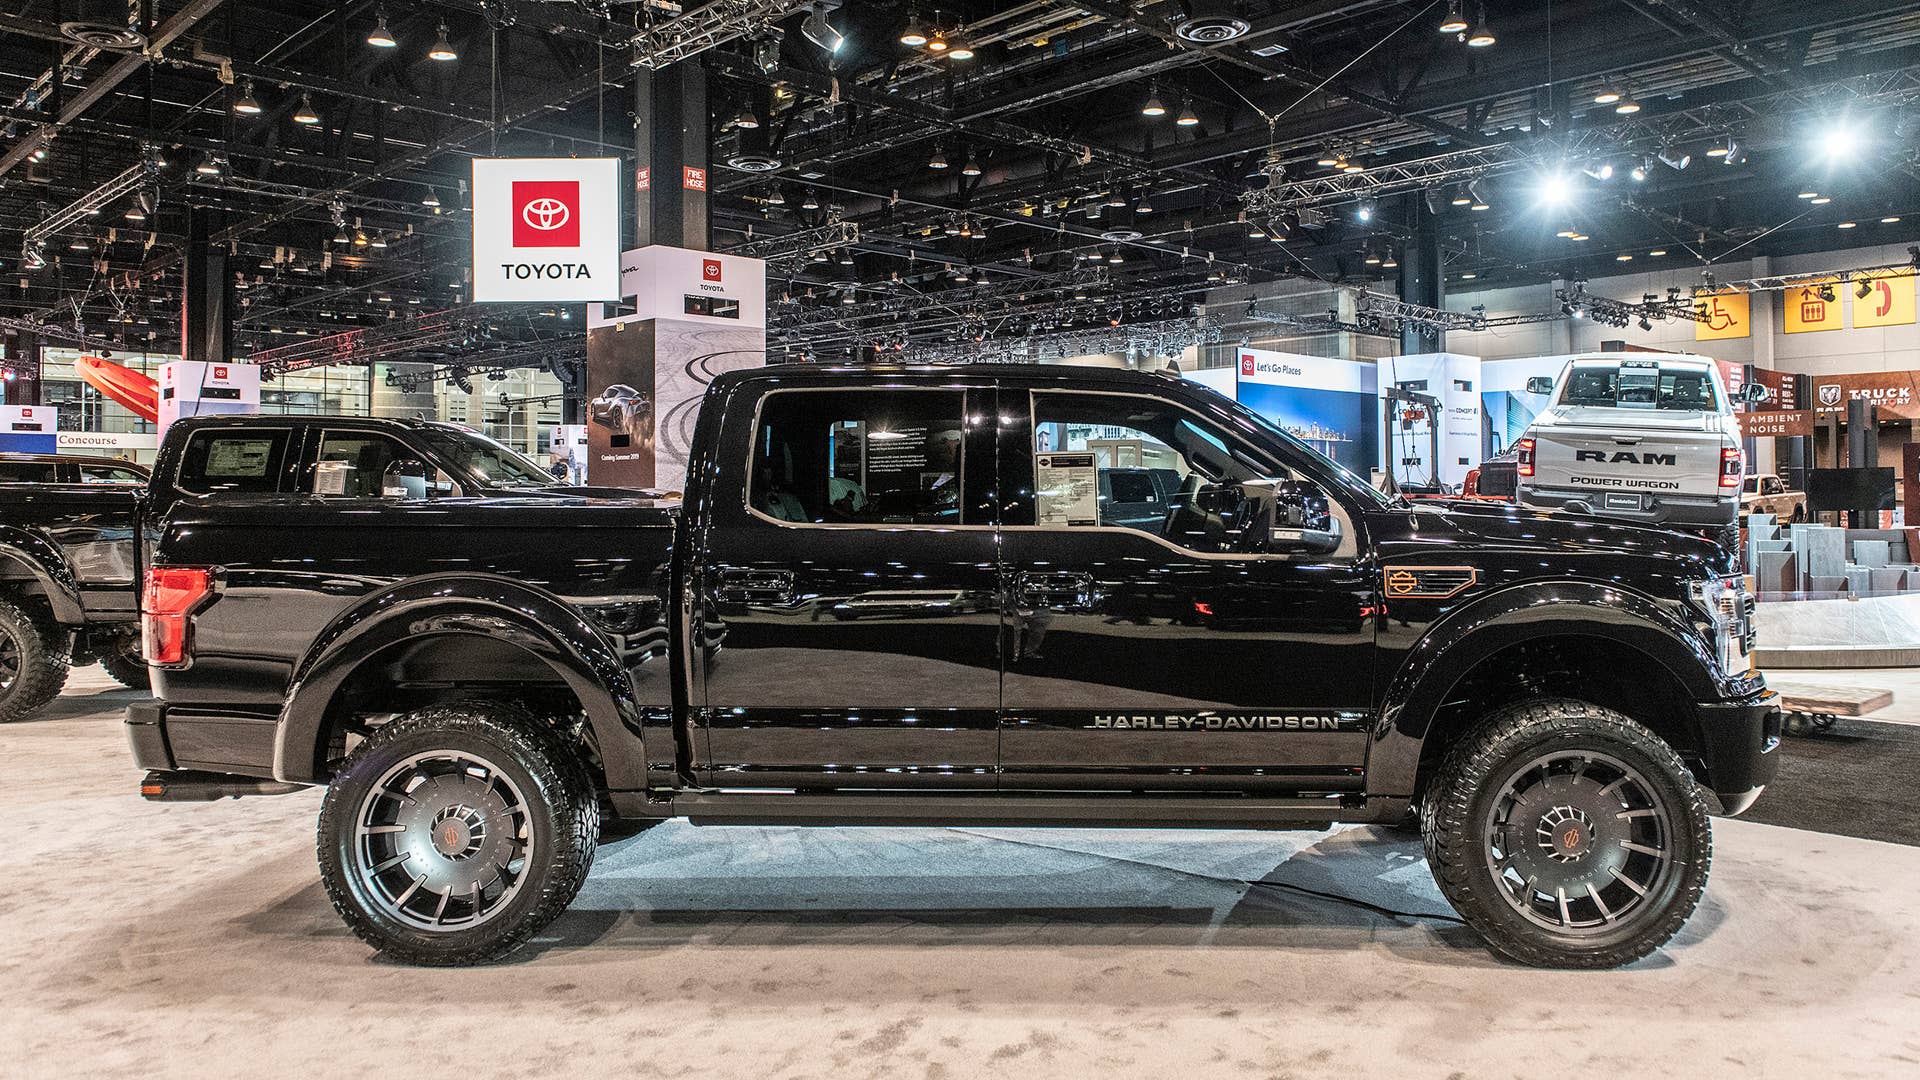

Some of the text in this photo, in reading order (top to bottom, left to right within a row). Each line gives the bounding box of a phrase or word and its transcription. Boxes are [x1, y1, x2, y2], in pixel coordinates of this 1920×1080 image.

[638, 170, 648, 179] FIRE
[687, 169, 703, 179] FIRE
[637, 179, 649, 188] HOSE
[686, 179, 704, 188] HOSE
[501, 263, 592, 280] TOYOTA
[700, 284, 725, 293] TOYOTA
[1256, 362, 1302, 376] Let's Go Places
[1848, 387, 1911, 400] TRUCK
[1750, 414, 1802, 424] AMBIENT
[1750, 425, 1786, 434] NOISE
[58, 434, 118, 446] Concourse
[601, 454, 616, 462] Coming
[1575, 449, 1677, 466] RAM
[1570, 476, 1680, 490] POWER WAGON
[1094, 715, 1339, 730] HARLEY-DAVIDSON
